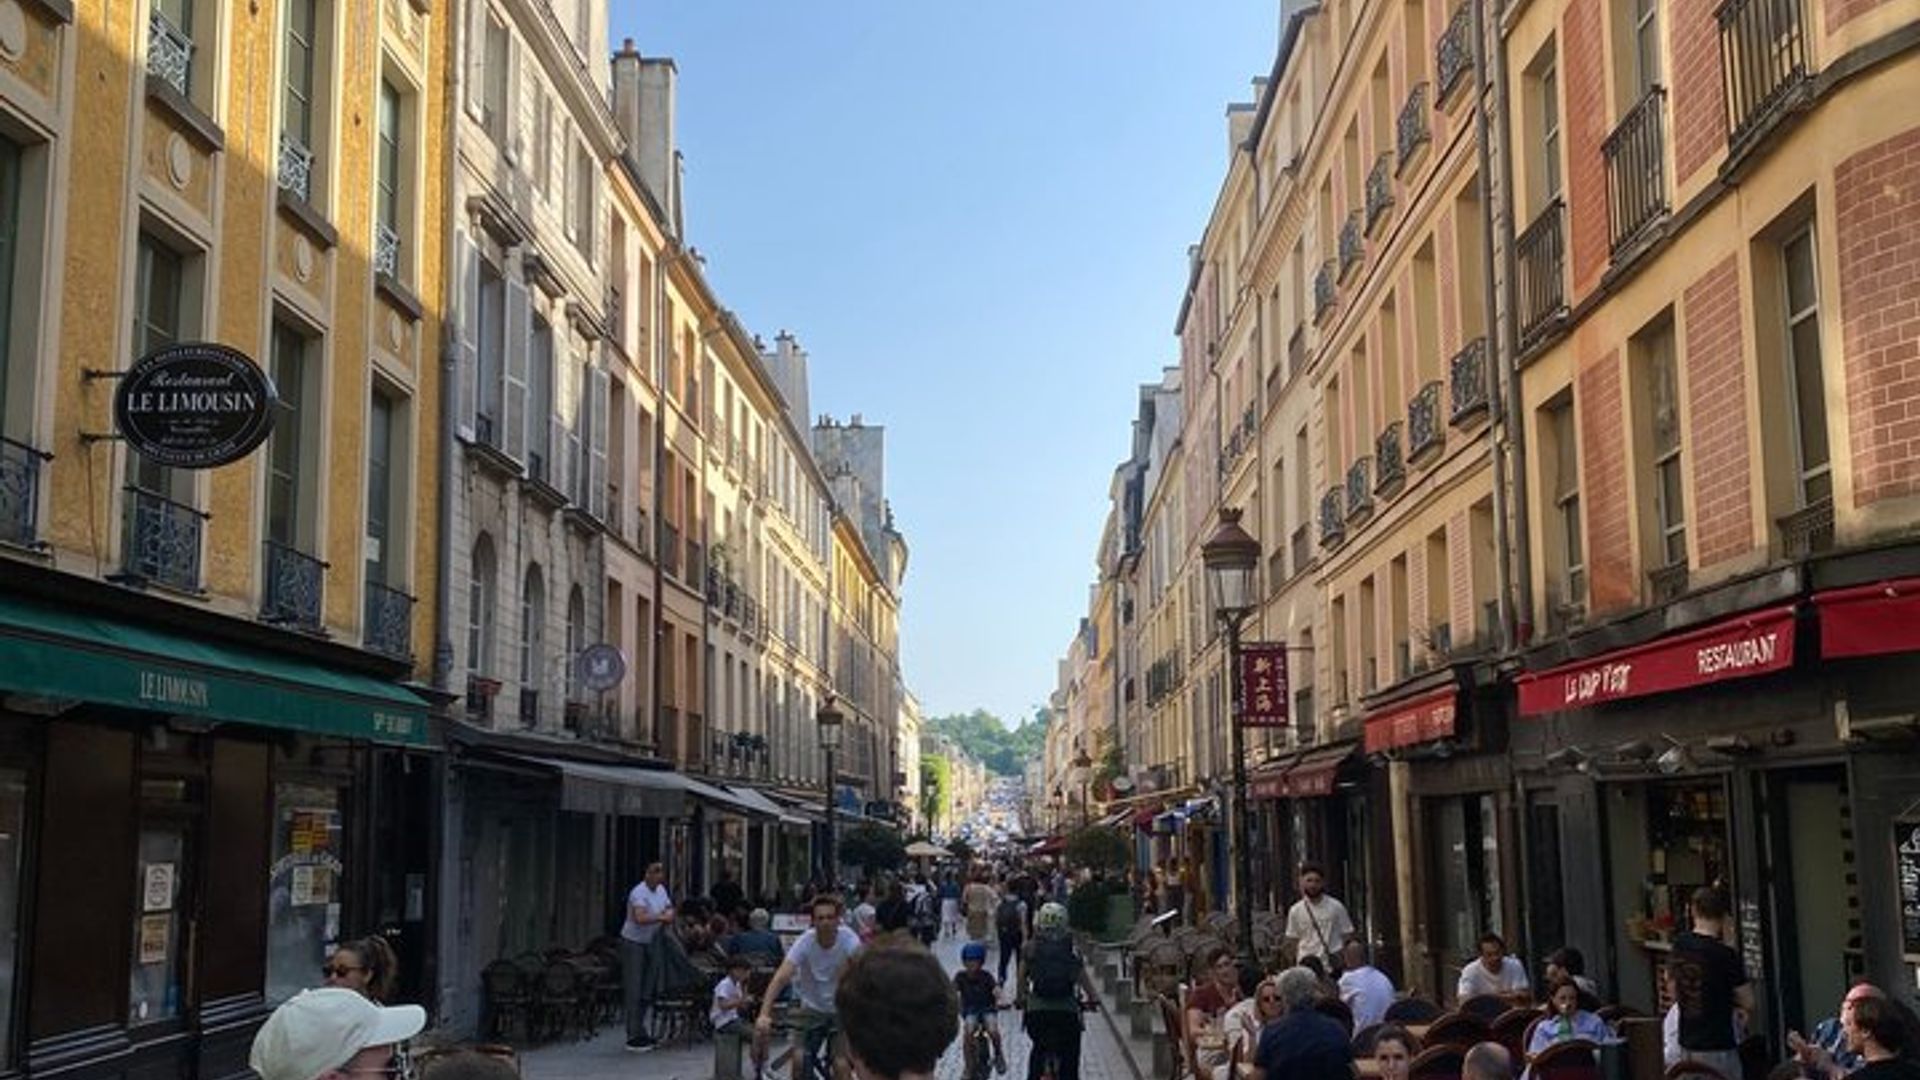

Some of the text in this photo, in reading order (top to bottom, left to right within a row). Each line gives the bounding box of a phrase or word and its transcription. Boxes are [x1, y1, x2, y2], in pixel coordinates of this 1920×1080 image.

[150, 370, 234, 387] Restaurant
[128, 391, 256, 411] LE LIMOUSIN
[1697, 634, 1777, 674] RESTAURANT
[141, 671, 208, 706] LE LIMOUSIN
